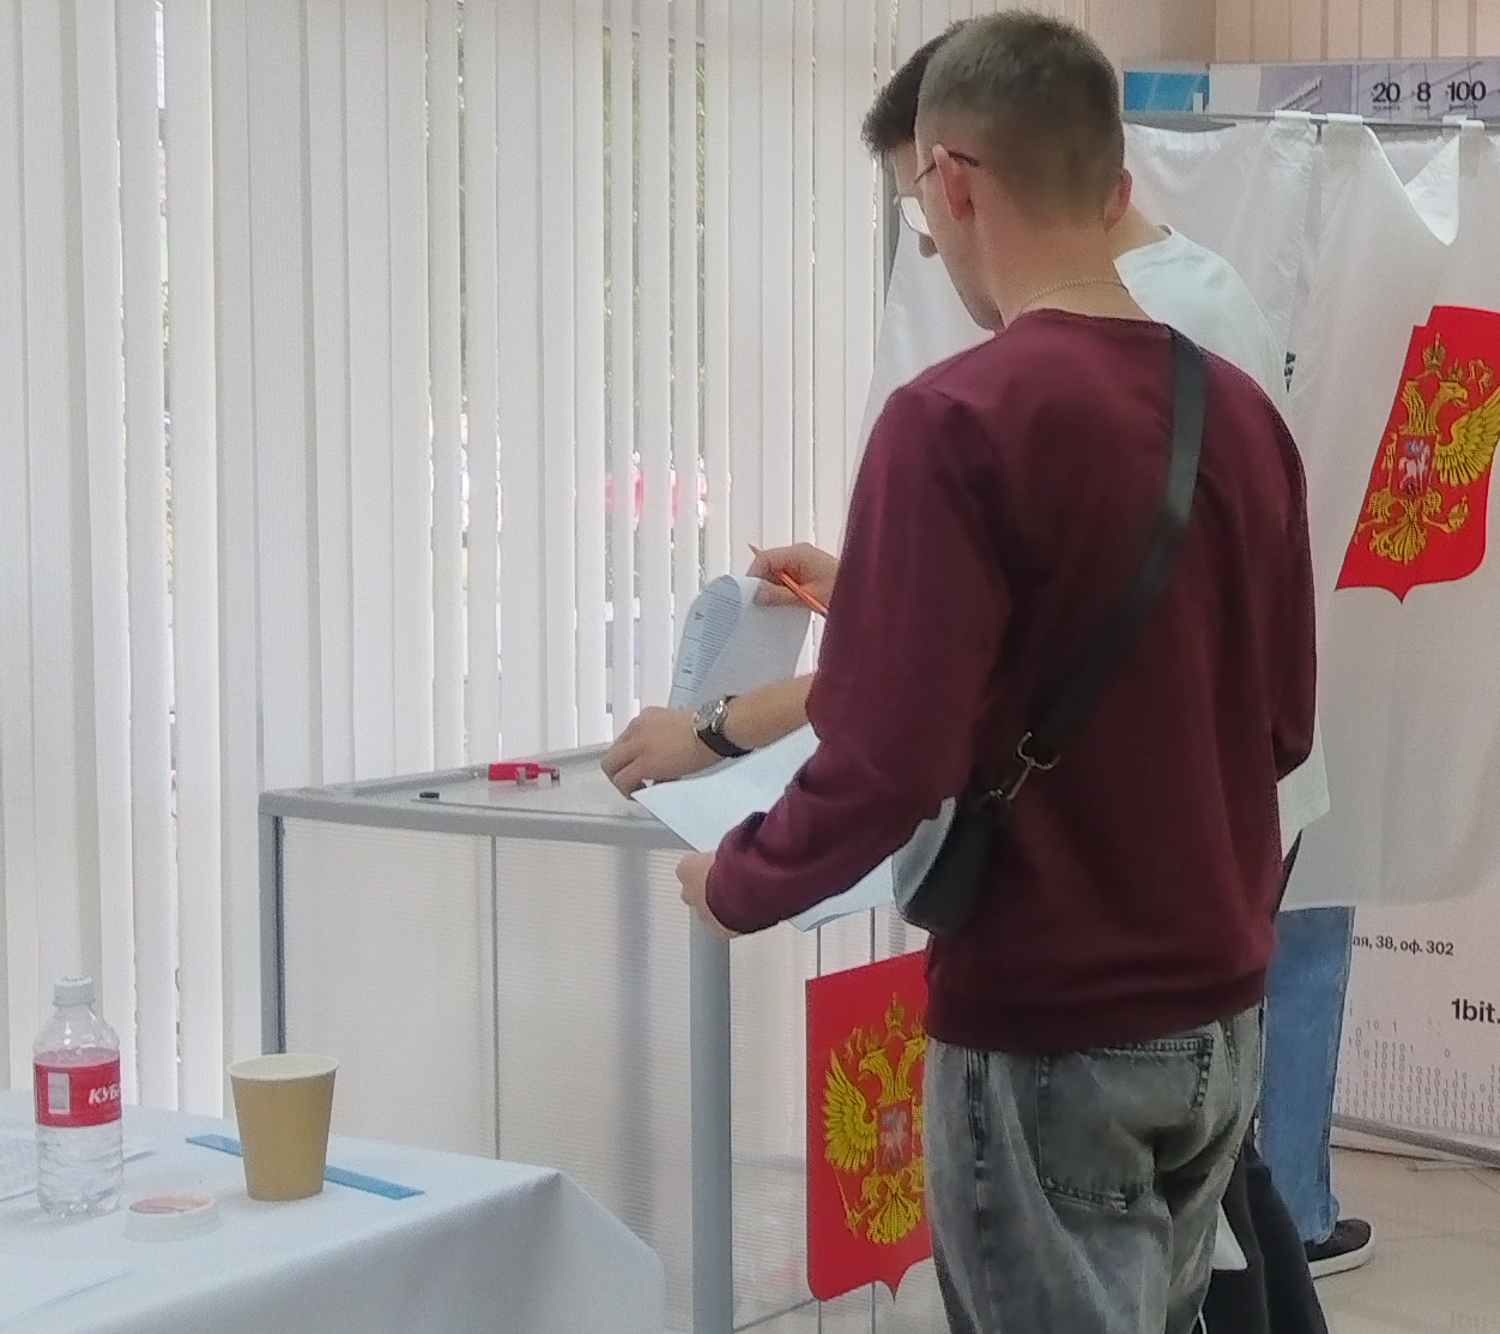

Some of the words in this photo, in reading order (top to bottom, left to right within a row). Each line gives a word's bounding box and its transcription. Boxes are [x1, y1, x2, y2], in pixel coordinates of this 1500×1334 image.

[1375, 934, 1398, 953] 38,
[1400, 939, 1423, 955] оф.
[1426, 940, 1454, 956] 302
